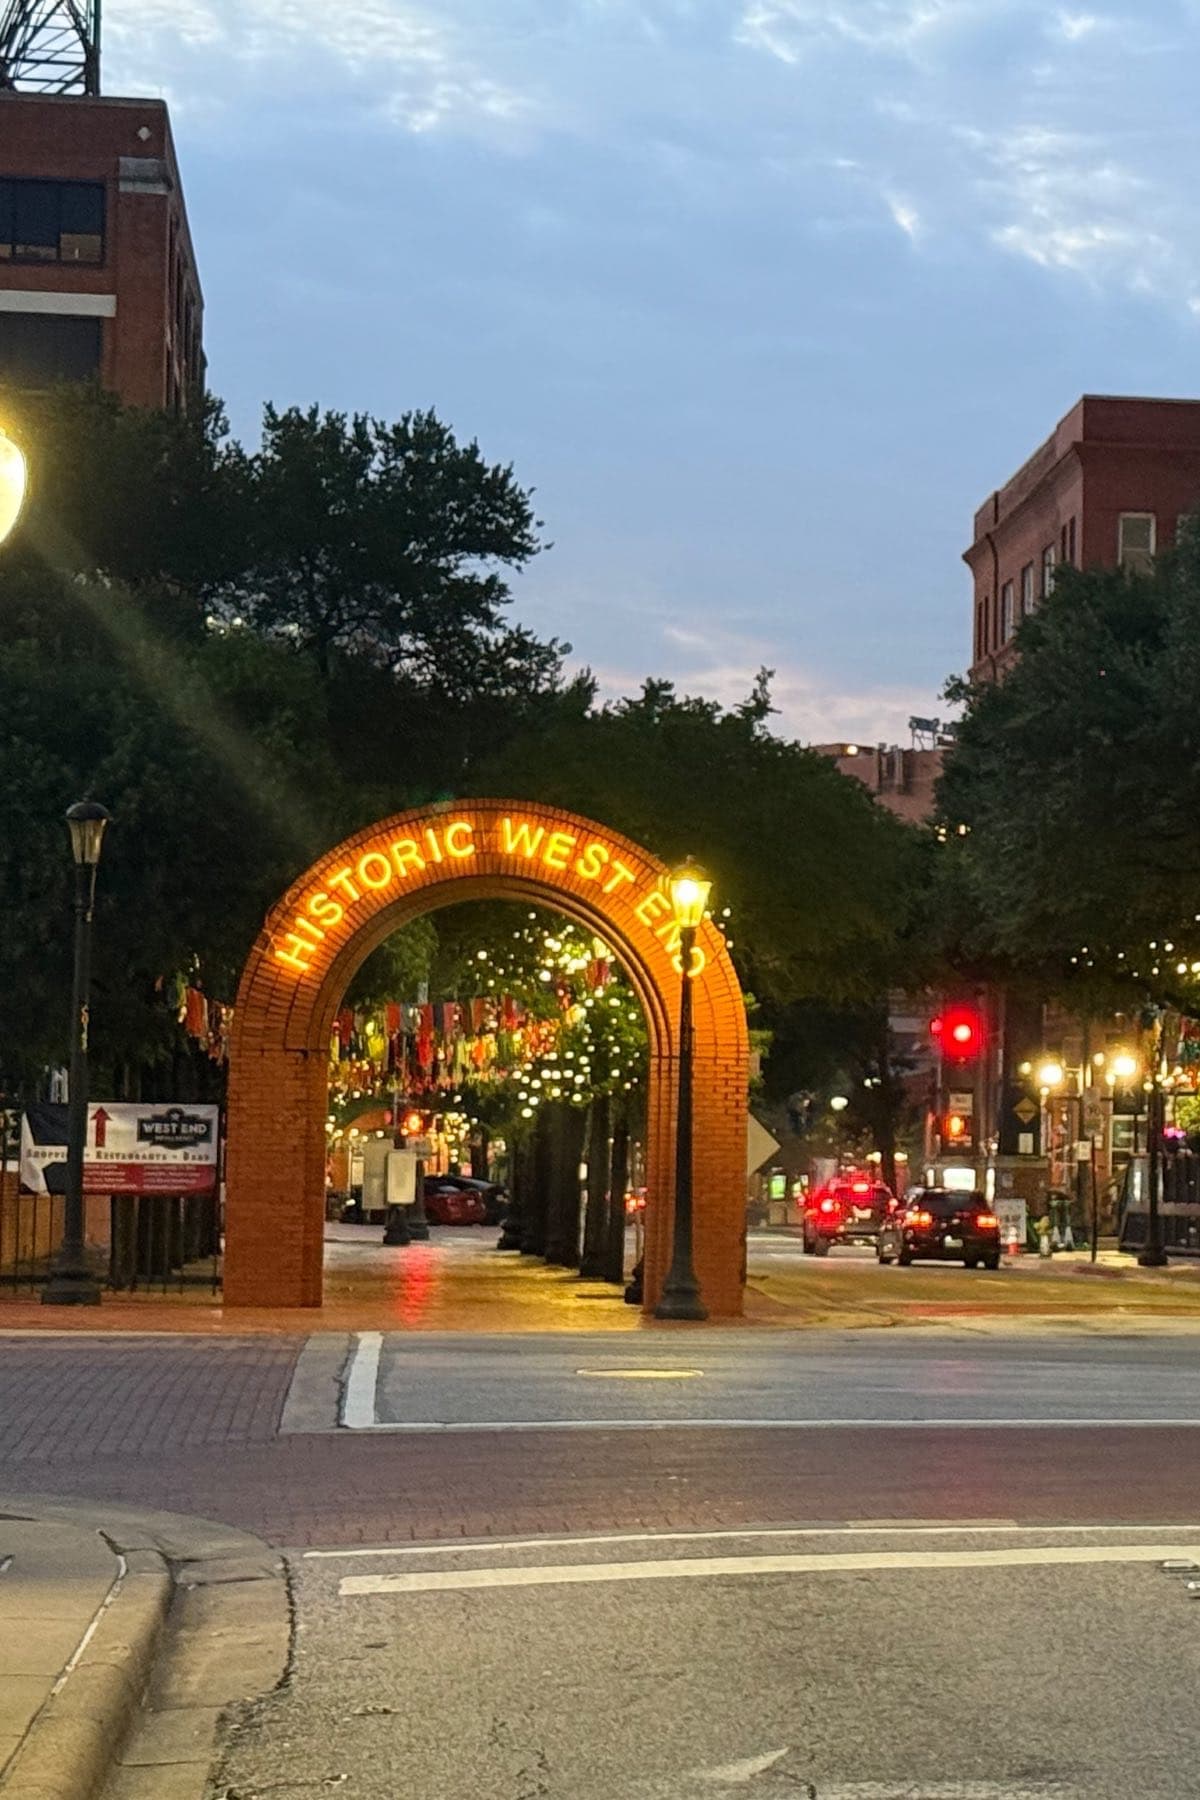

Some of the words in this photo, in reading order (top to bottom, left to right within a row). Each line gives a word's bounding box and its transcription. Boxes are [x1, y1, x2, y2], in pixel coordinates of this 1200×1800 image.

[274, 821, 476, 971] HISTORIC
[502, 817, 637, 894] WEST
[142, 1122, 179, 1134] WEST
[181, 1122, 208, 1135] END
[26, 1148, 65, 1159] SHOPPI
